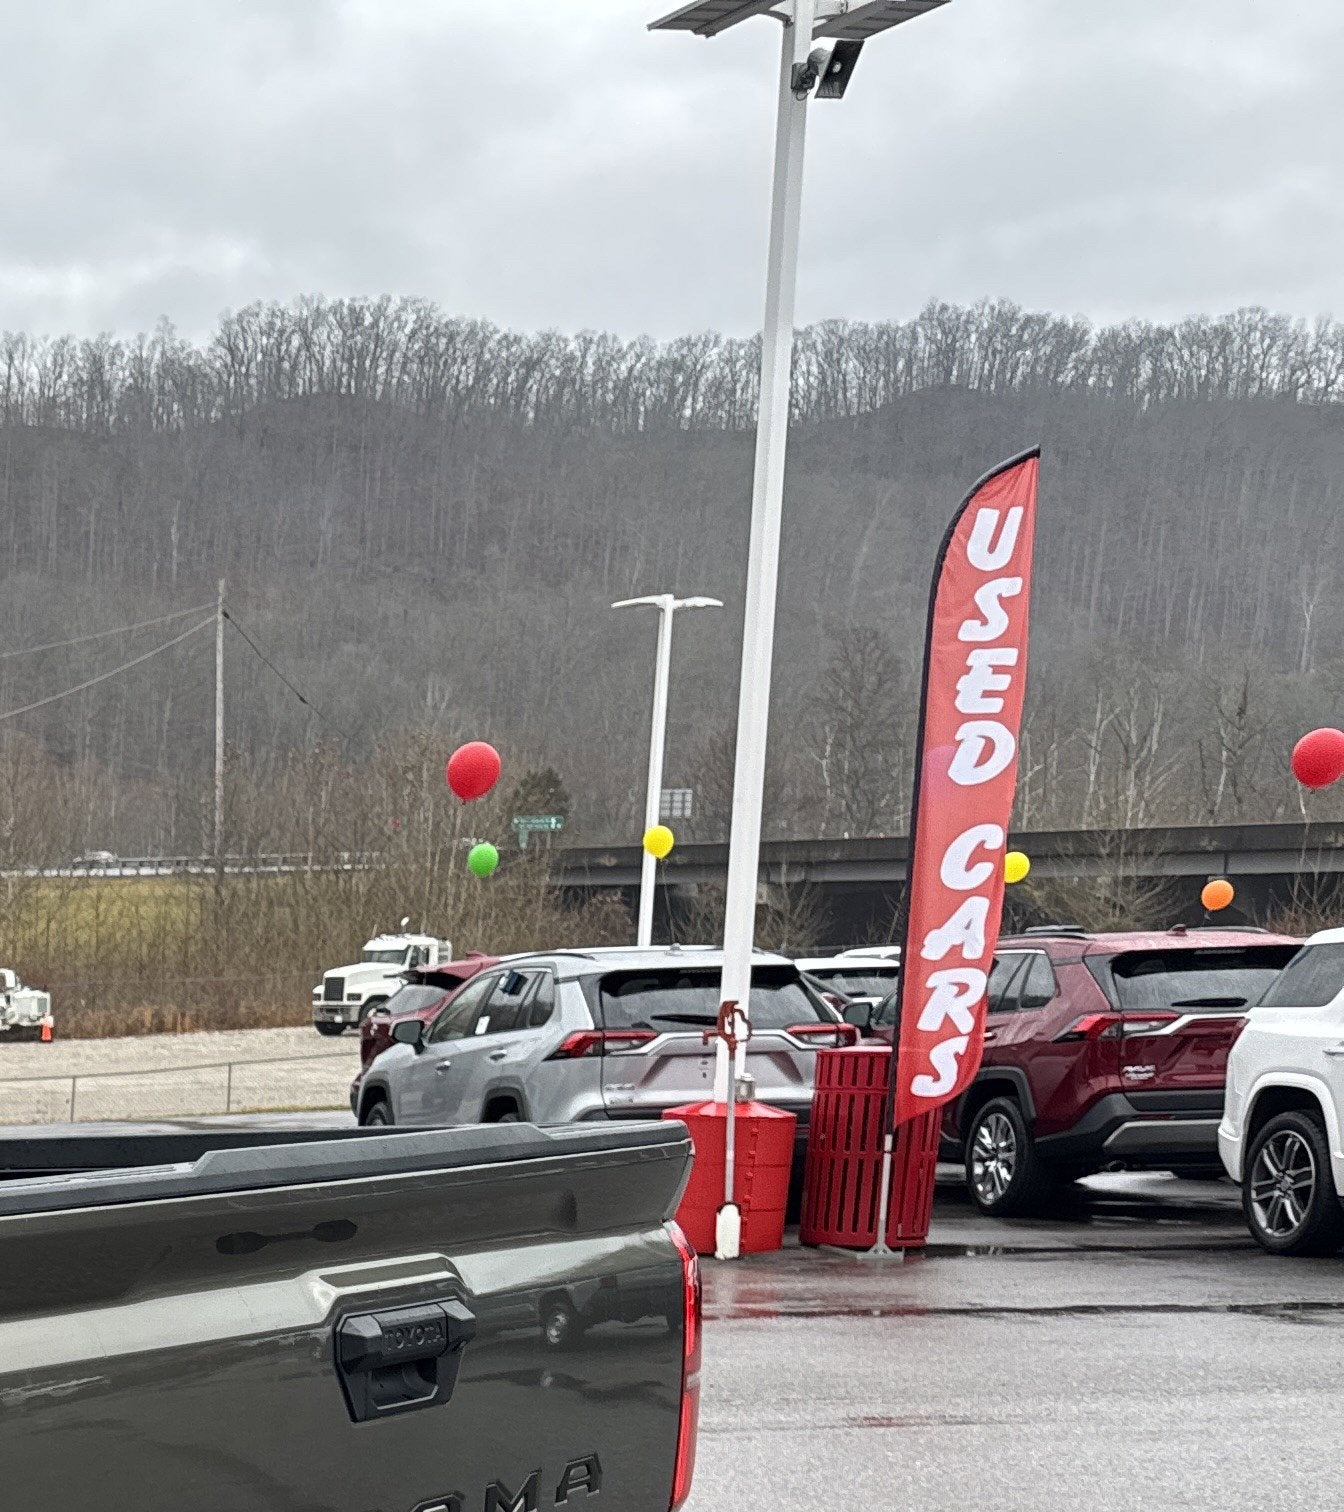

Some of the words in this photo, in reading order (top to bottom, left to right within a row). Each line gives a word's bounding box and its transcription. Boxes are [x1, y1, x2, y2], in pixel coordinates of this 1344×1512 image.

[947, 506, 1024, 786] USED
[910, 823, 1004, 1097] CARS
[382, 1321, 446, 1352] TOYOTA
